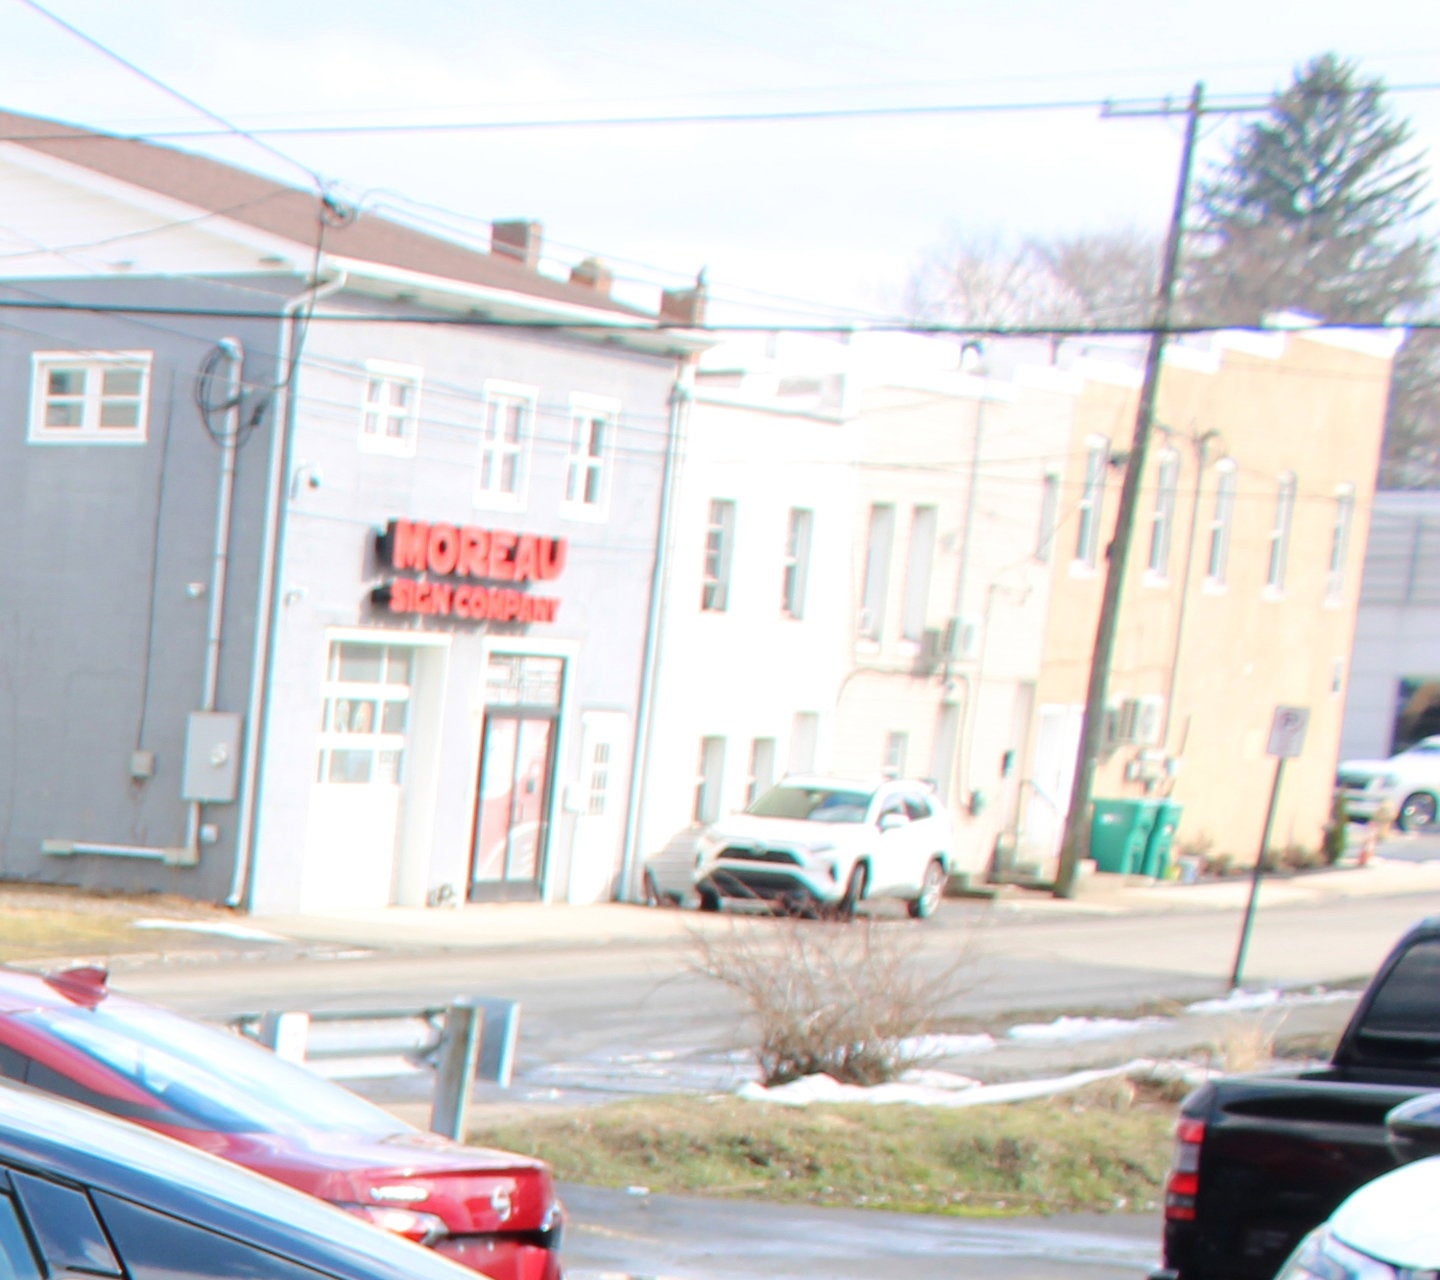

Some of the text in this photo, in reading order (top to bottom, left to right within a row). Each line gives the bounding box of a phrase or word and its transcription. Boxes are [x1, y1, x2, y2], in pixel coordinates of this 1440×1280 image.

[393, 517, 568, 581] MOREAU
[389, 578, 559, 623] SIGN COMPANY
